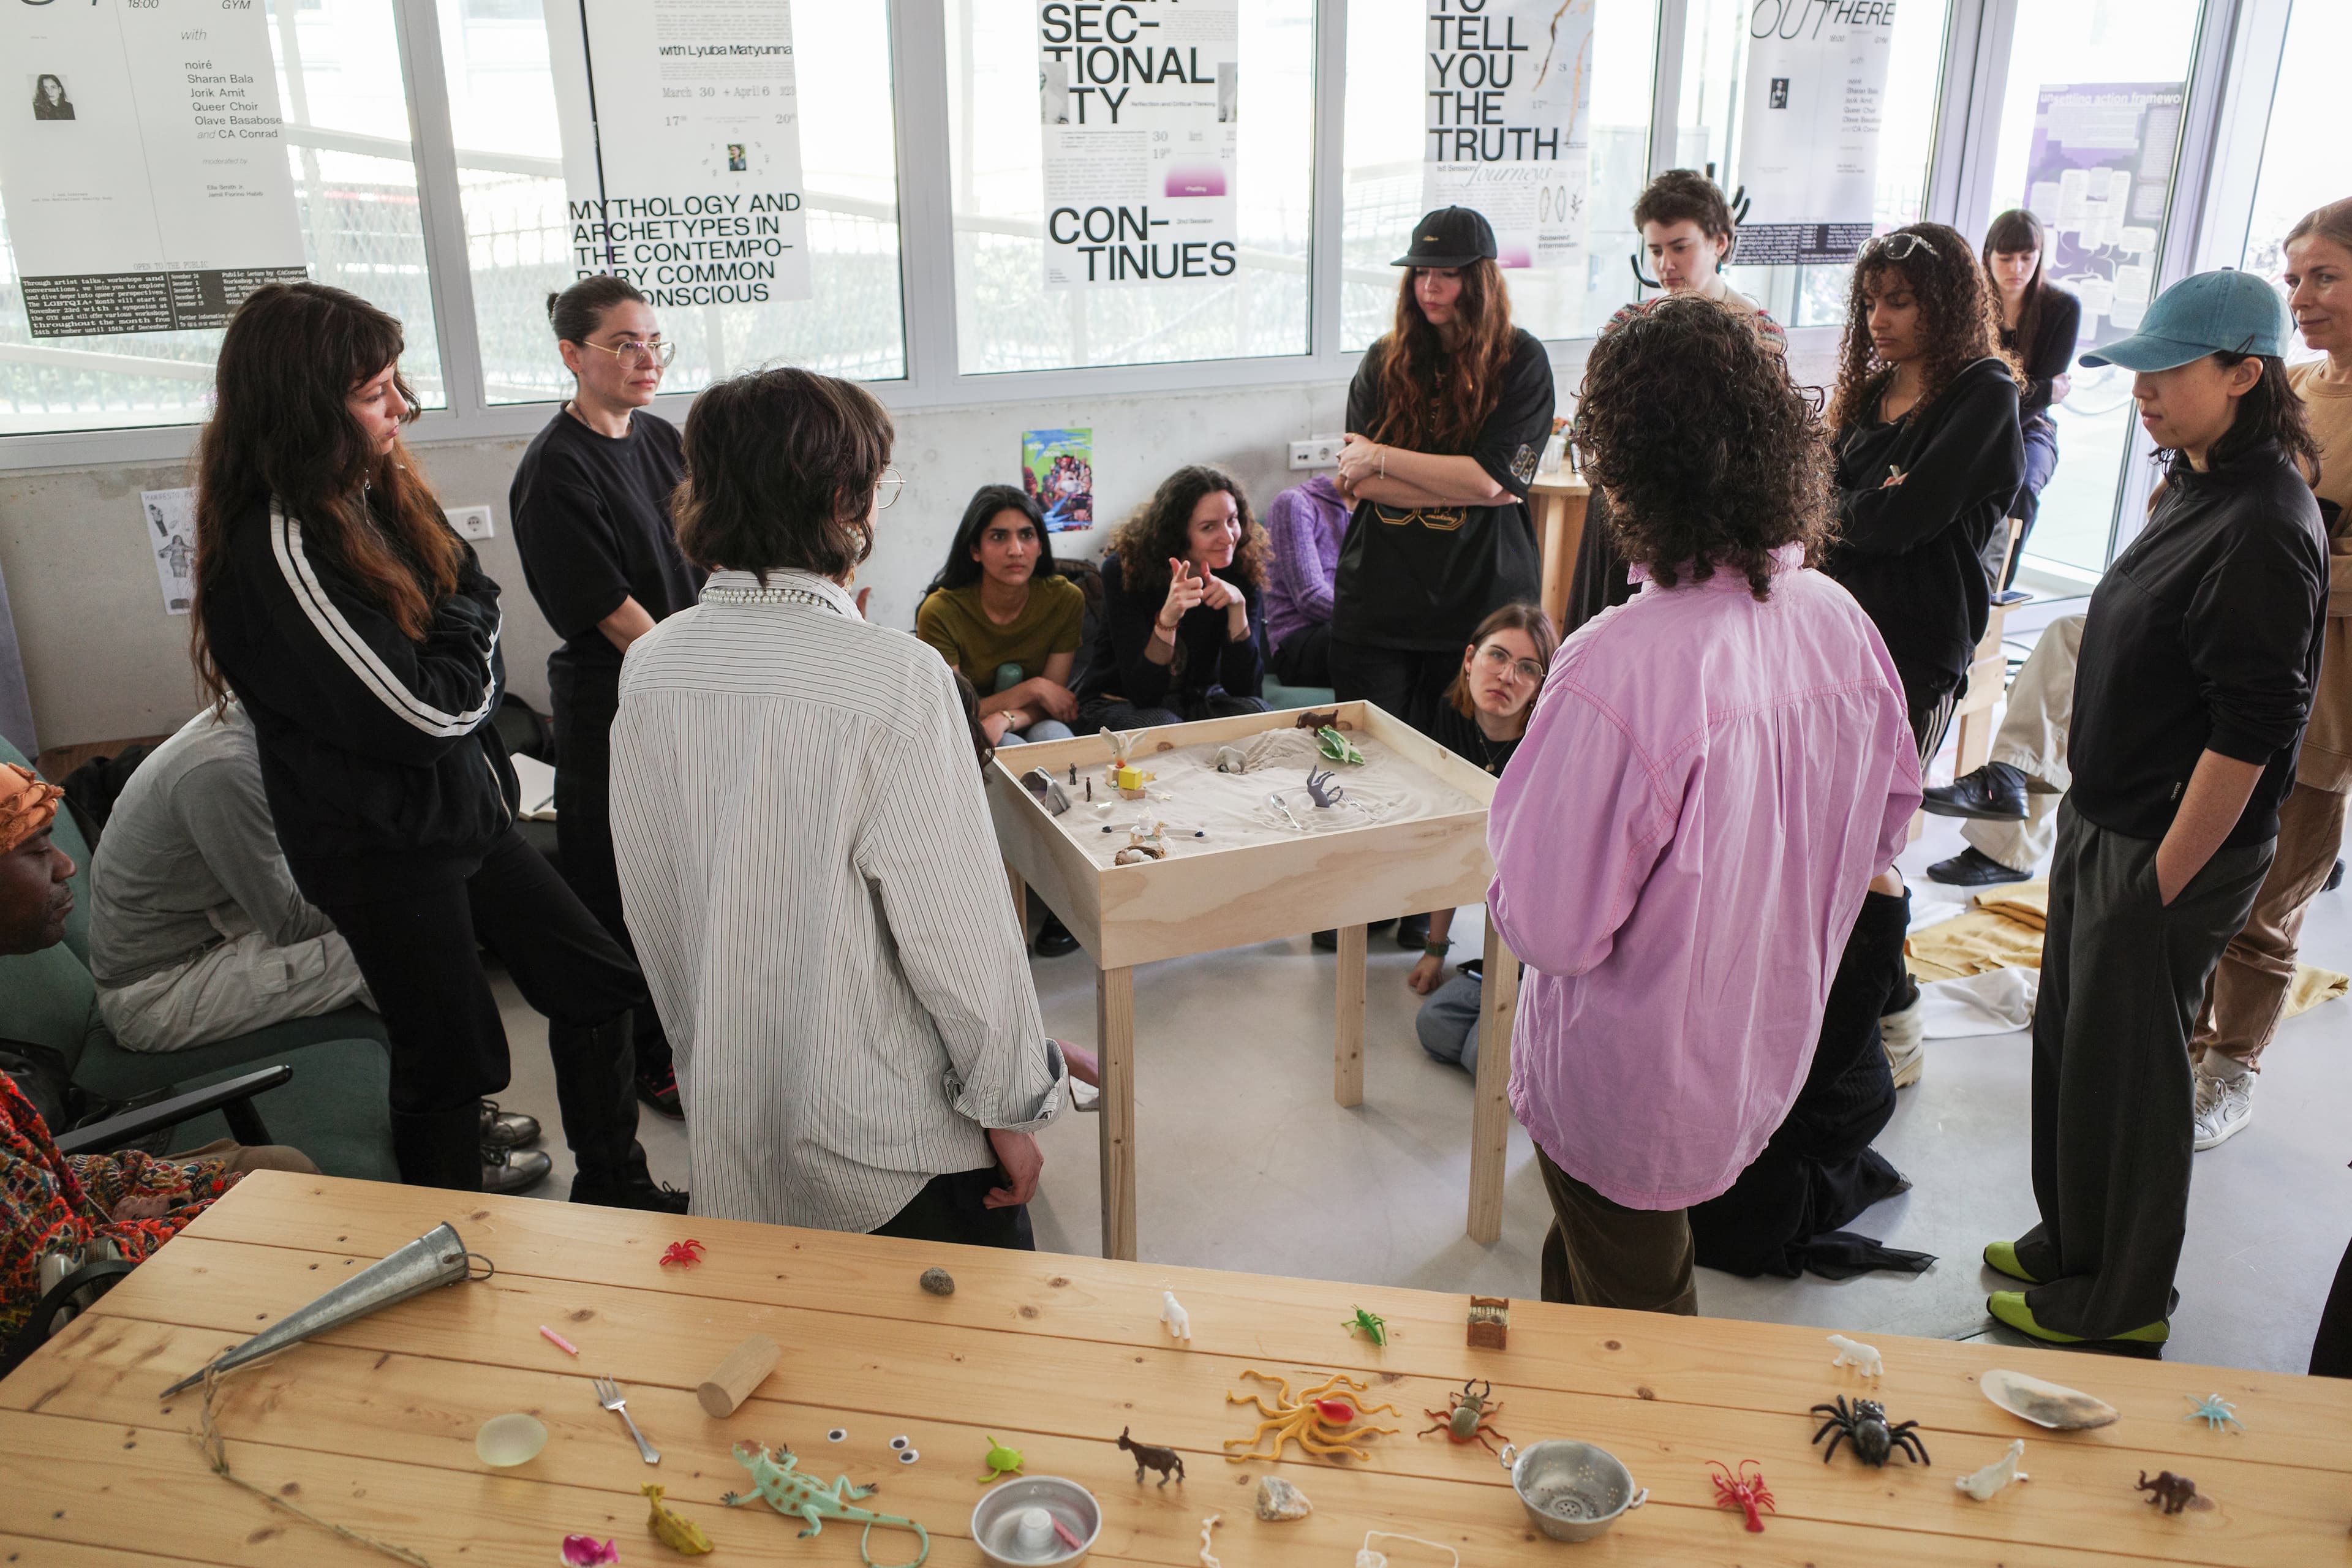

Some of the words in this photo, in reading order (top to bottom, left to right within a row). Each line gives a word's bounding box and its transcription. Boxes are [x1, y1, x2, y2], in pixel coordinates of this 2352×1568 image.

[222, 0, 251, 9] GYM
[1042, 4, 1159, 43] SEC-
[1751, 0, 1827, 40] OUT
[181, 29, 206, 40] with
[1430, 15, 1528, 51] TELL
[659, 45, 686, 56] with
[688, 45, 726, 58] Lyuba
[729, 45, 793, 57] Matyunina
[185, 60, 212, 69] noiré
[1043, 46, 1215, 85] TIONAL
[1430, 53, 1513, 89] YOU
[187, 74, 226, 83] Sharan
[230, 74, 254, 83] Bala
[190, 88, 215, 97] Jorik
[219, 88, 246, 97] Amit
[662, 88, 693, 98] March
[699, 87, 715, 97] 30
[734, 86, 760, 99] April
[762, 86, 771, 97] 6
[2095, 93, 2128, 105] action
[192, 102, 225, 111] Queer
[230, 102, 258, 111] Choir
[1430, 91, 1505, 125] THE
[195, 116, 226, 125] Olave
[230, 115, 283, 125] Basabose
[218, 129, 236, 138] CA
[239, 129, 278, 138] Conrad
[1152, 130, 1168, 142] 30
[1429, 127, 1558, 162] TRUTH
[569, 195, 741, 221] MYTHOLOGY
[750, 193, 801, 213] AND
[575, 217, 750, 243] ARCHETYPES
[756, 216, 779, 235] IN
[1050, 206, 1169, 244] CON-
[575, 246, 627, 266] THE
[635, 238, 793, 263] CONTEMPO-
[1077, 241, 1236, 281] TINUES
[184, 260, 208, 269] PUBLIC
[657, 261, 775, 285] COMMON
[639, 284, 769, 307] ONSCIOUS
